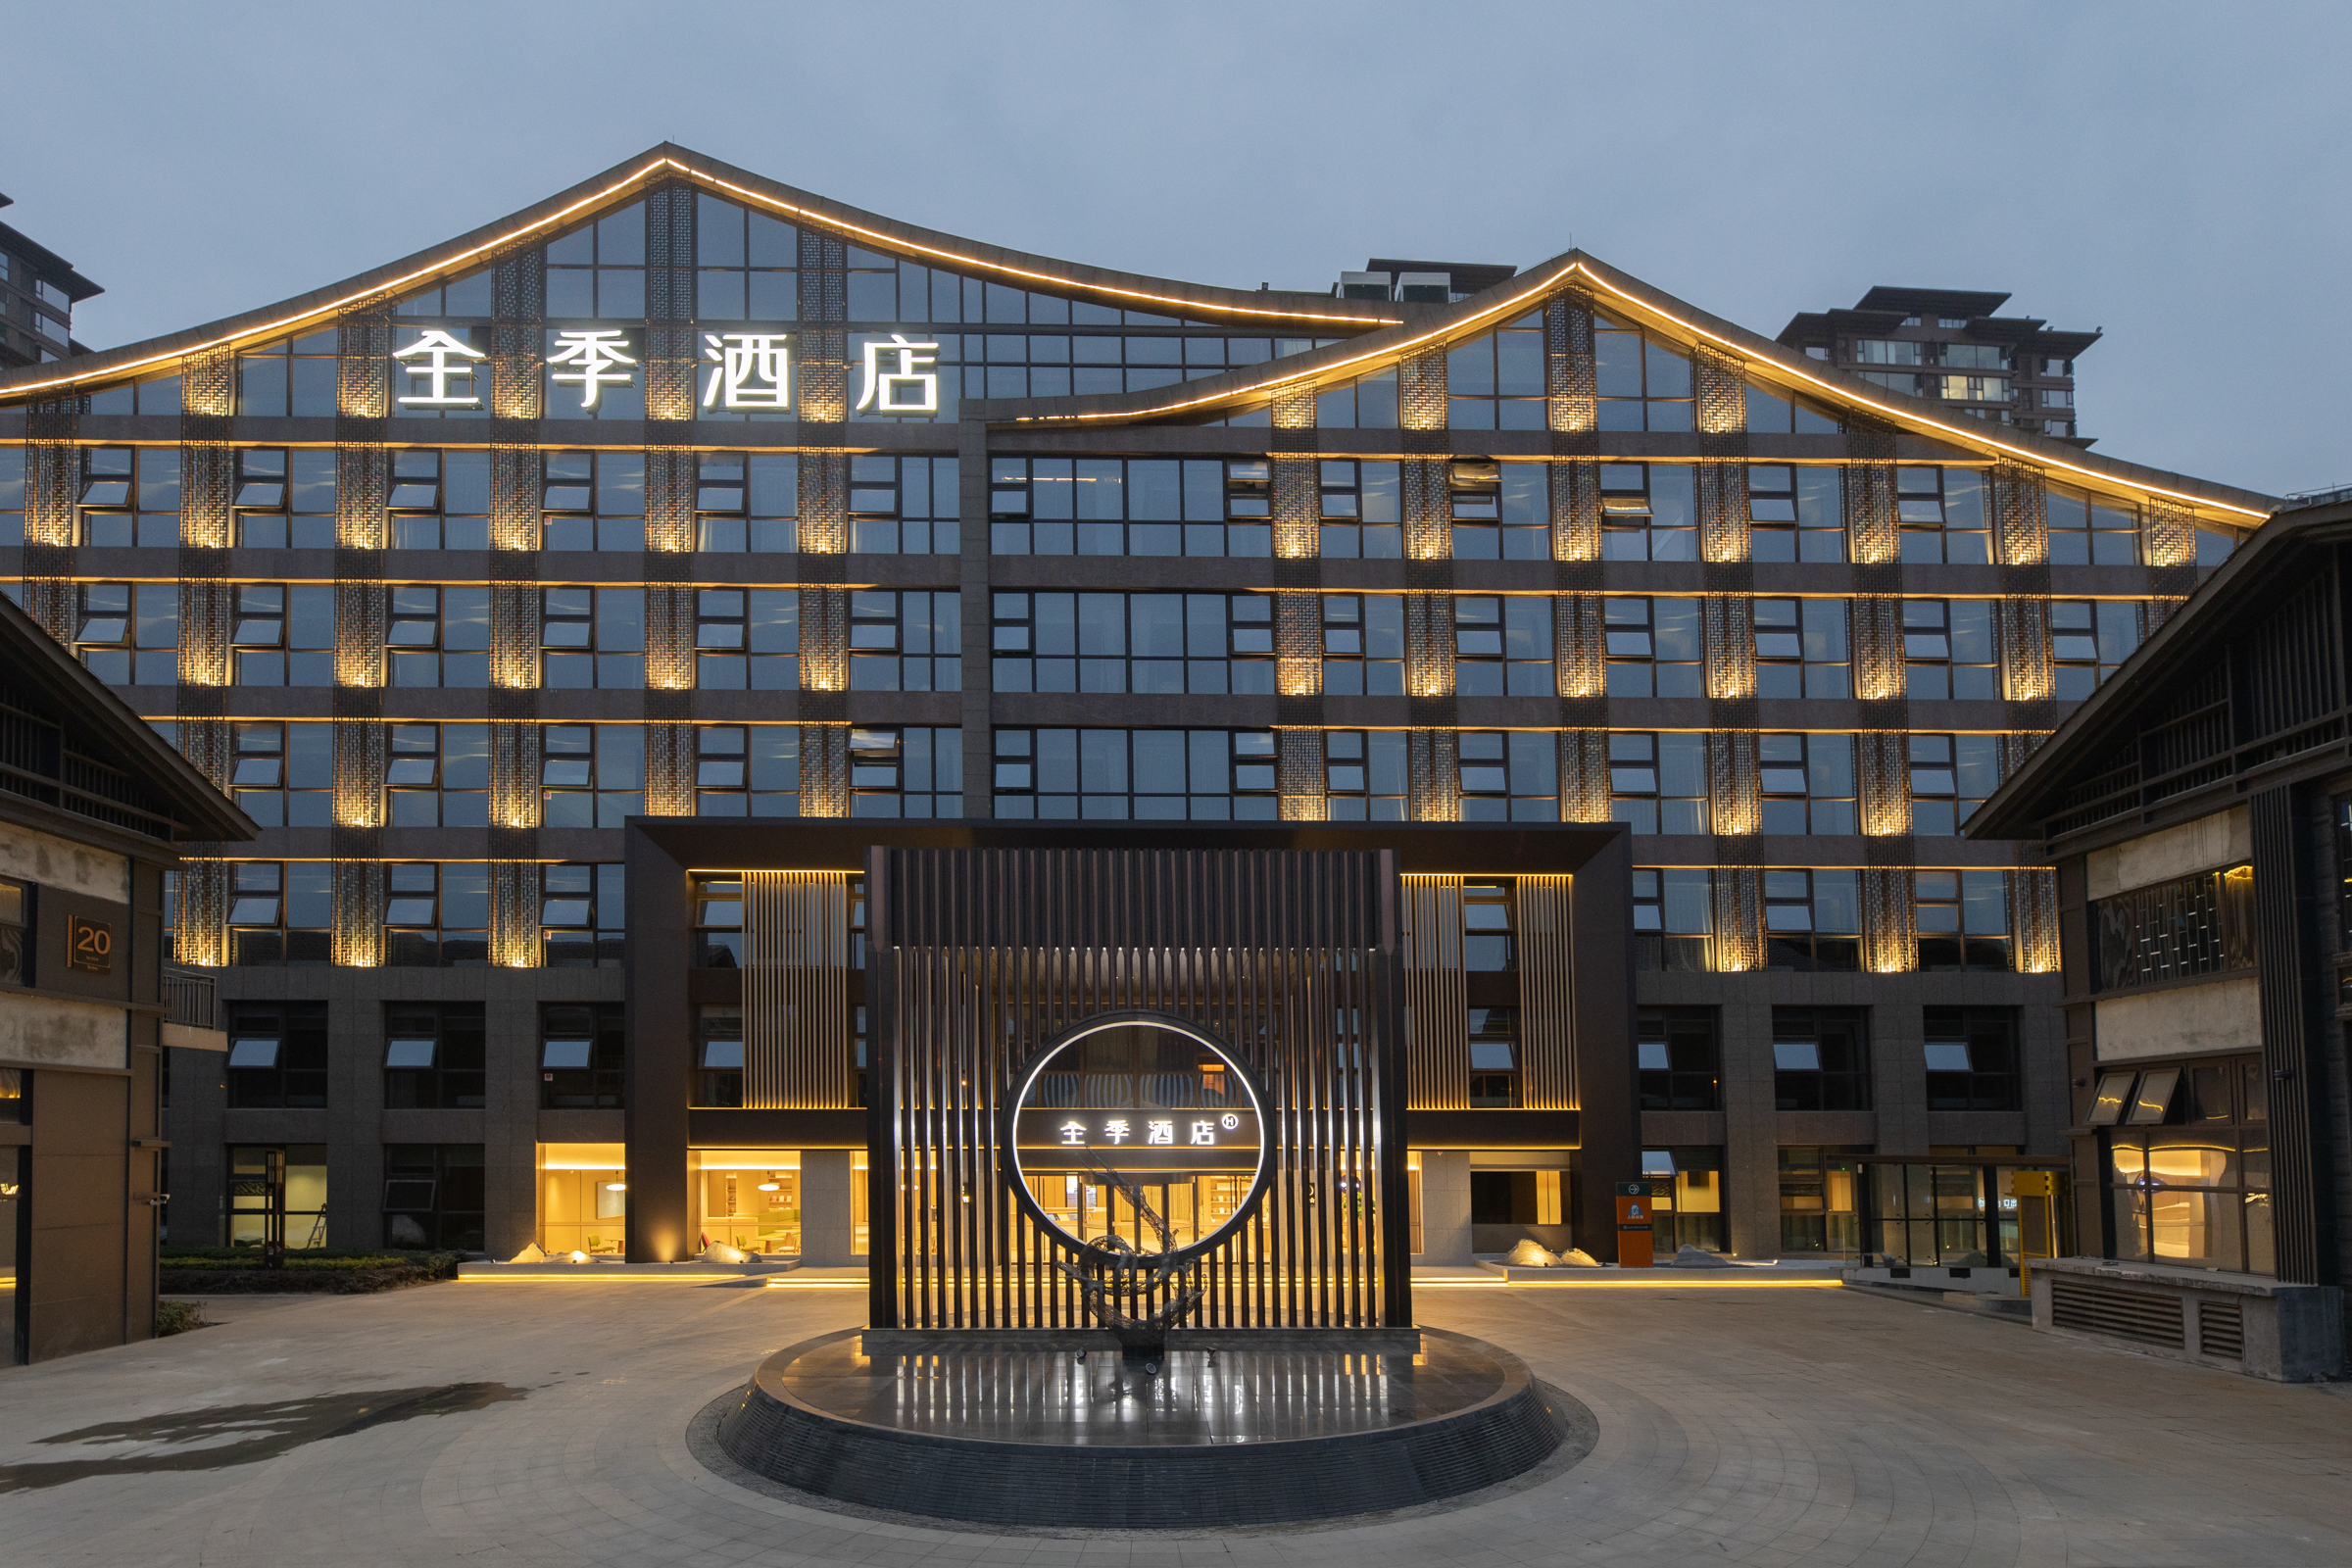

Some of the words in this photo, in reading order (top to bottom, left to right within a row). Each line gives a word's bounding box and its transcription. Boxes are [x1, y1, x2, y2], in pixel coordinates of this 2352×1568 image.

[392, 330, 940, 412] 全季酒店
[77, 926, 111, 955] 20
[1059, 1119, 1215, 1145] 全季酒店
